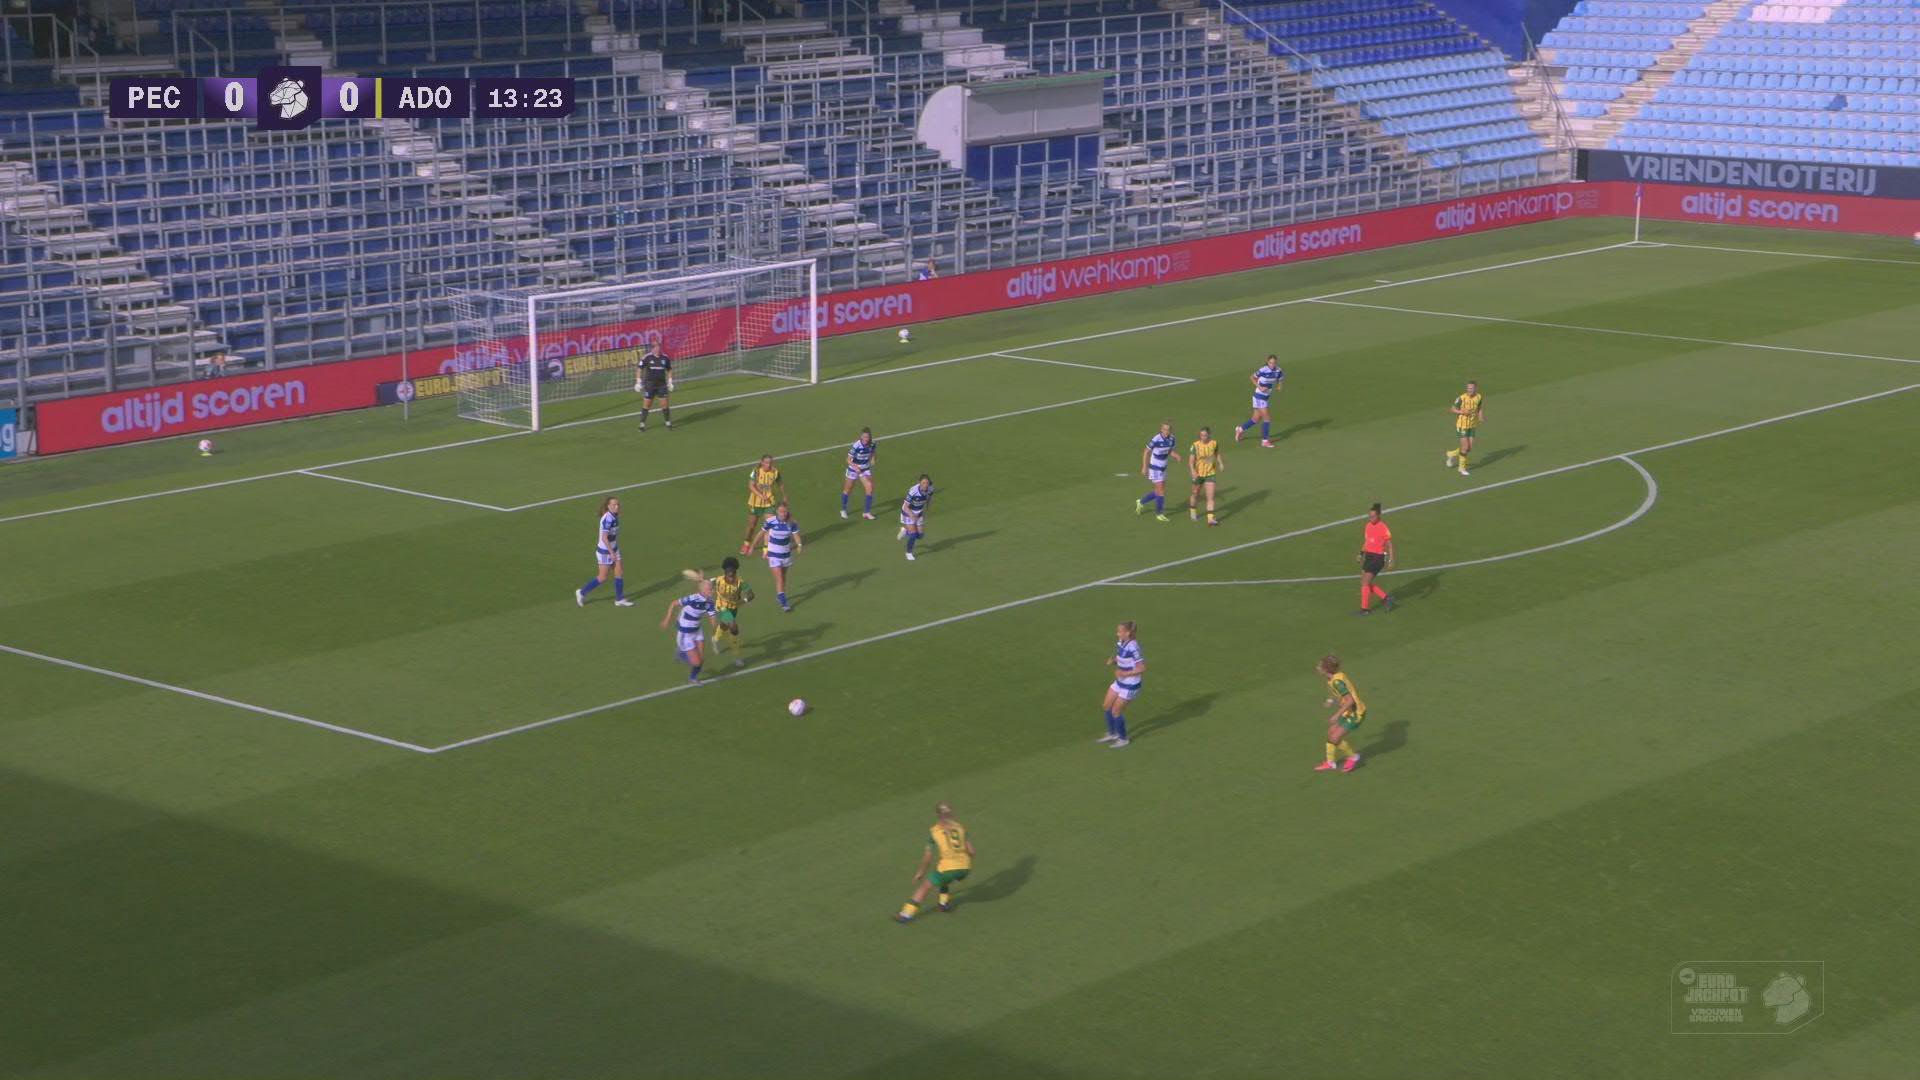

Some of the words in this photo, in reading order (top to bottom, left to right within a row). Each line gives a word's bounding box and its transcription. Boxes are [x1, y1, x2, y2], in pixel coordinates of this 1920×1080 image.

[1624, 154, 1877, 195] VRIENDENLOTERIJ
[1435, 201, 1476, 231] altijd
[1478, 191, 1573, 222] wehkamp
[1681, 191, 1742, 220] altijd
[1748, 199, 1839, 224] scoren
[1253, 230, 1297, 260] altijd
[1300, 224, 1361, 251] scoren
[1006, 267, 1057, 299] altijd
[1060, 254, 1171, 289] wehkamp
[833, 292, 912, 325] scoren
[101, 391, 184, 433] altijd
[191, 380, 305, 420] scoren
